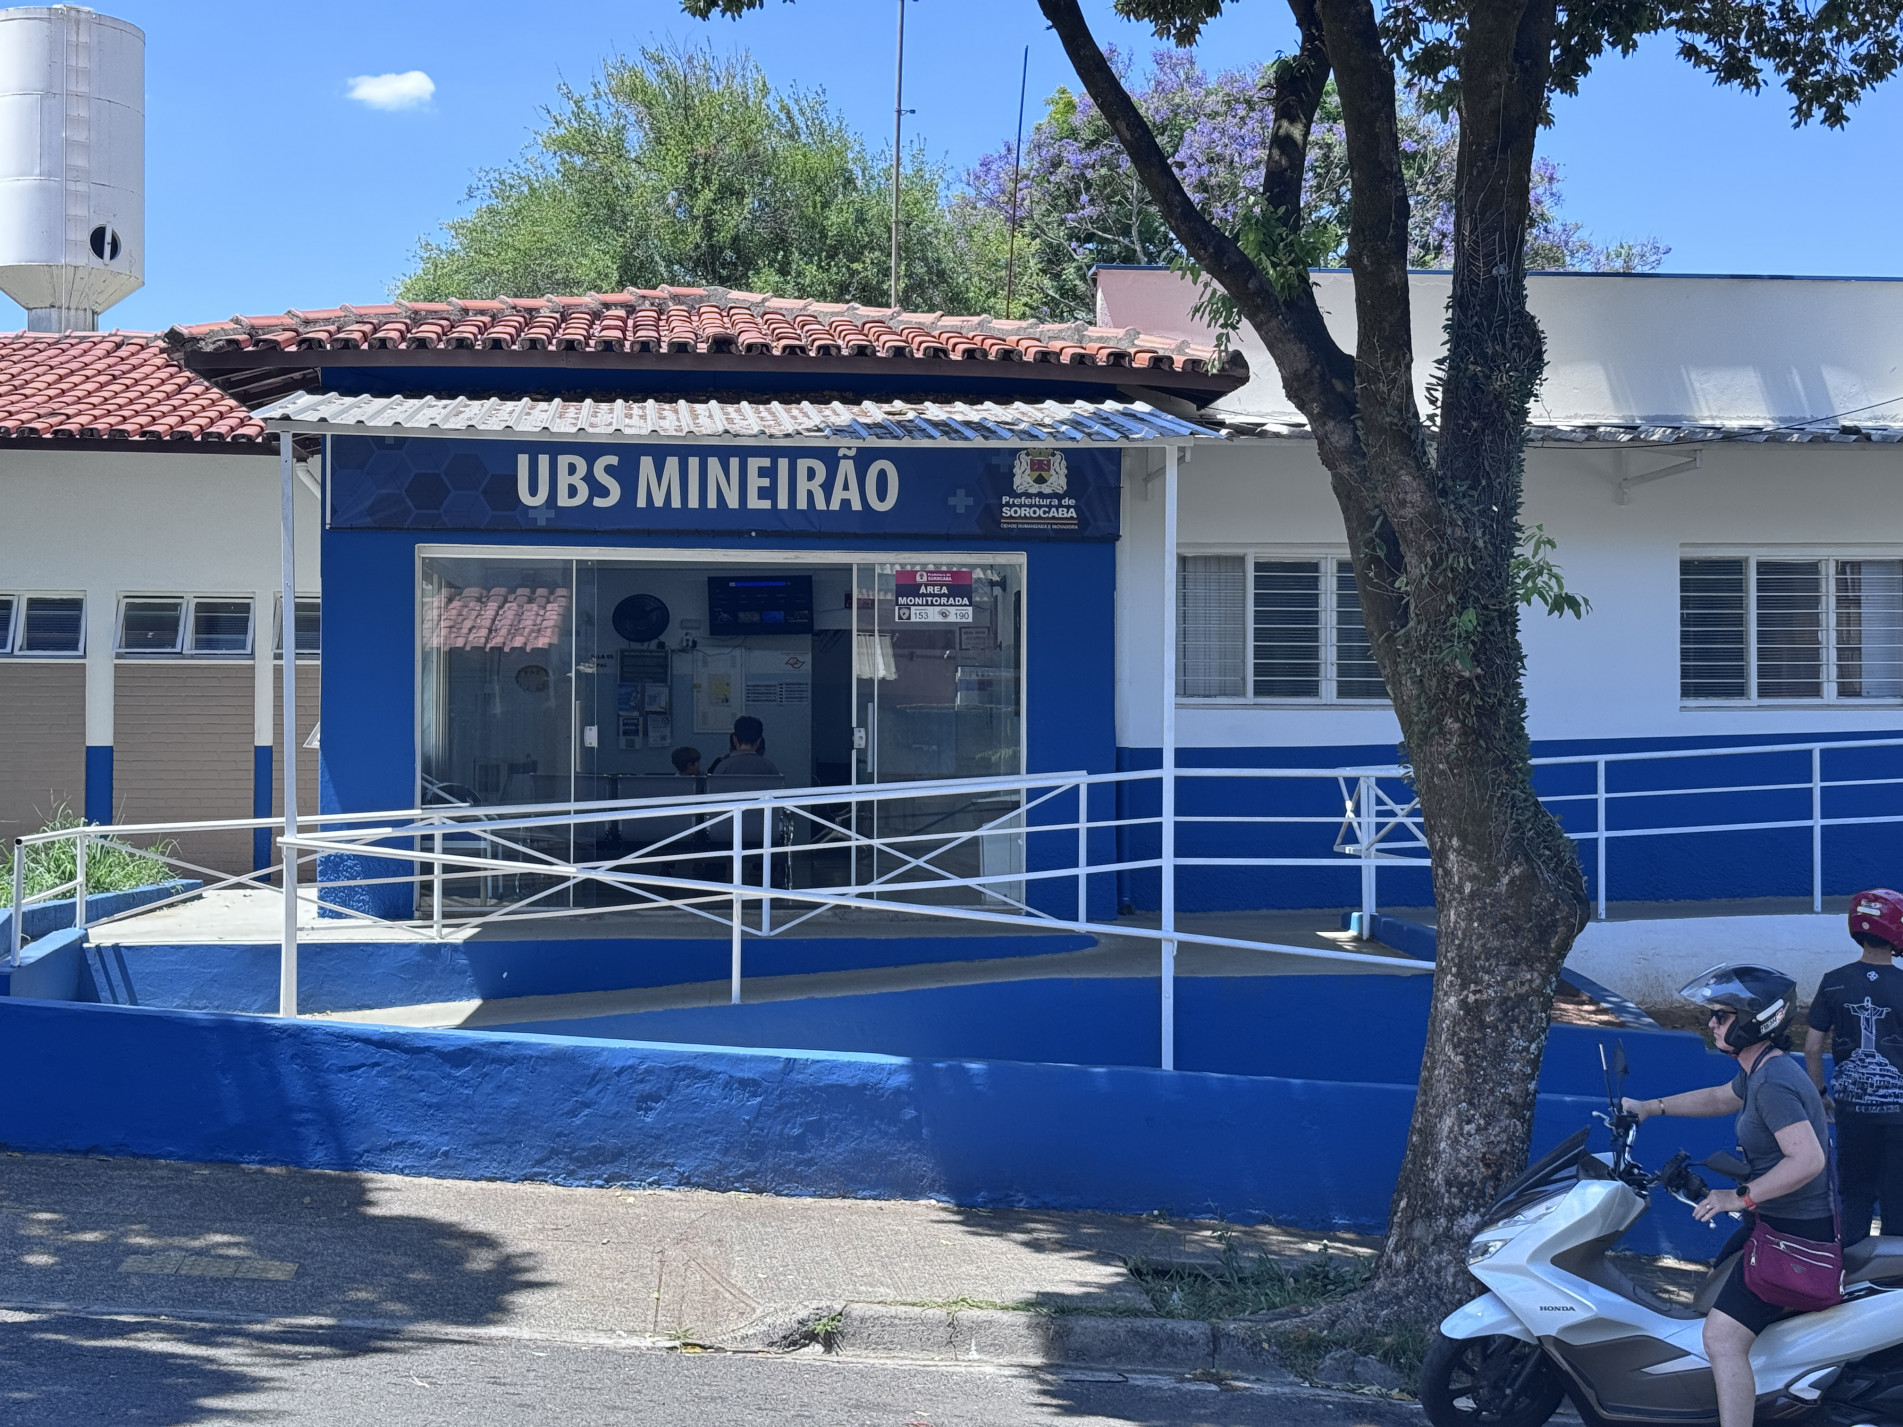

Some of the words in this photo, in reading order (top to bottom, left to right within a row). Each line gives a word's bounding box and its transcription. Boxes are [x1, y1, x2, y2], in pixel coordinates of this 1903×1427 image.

[517, 453, 621, 507] UBS
[636, 447, 899, 511] MINEIRÃO
[1002, 496, 1058, 505] Prefeitura
[1061, 497, 1076, 506] de
[1002, 507, 1077, 518] SOROCABA
[919, 584, 948, 594] ÁREA
[898, 597, 969, 605] MONITORADA
[914, 612, 929, 620] 153
[954, 612, 970, 620] 190
